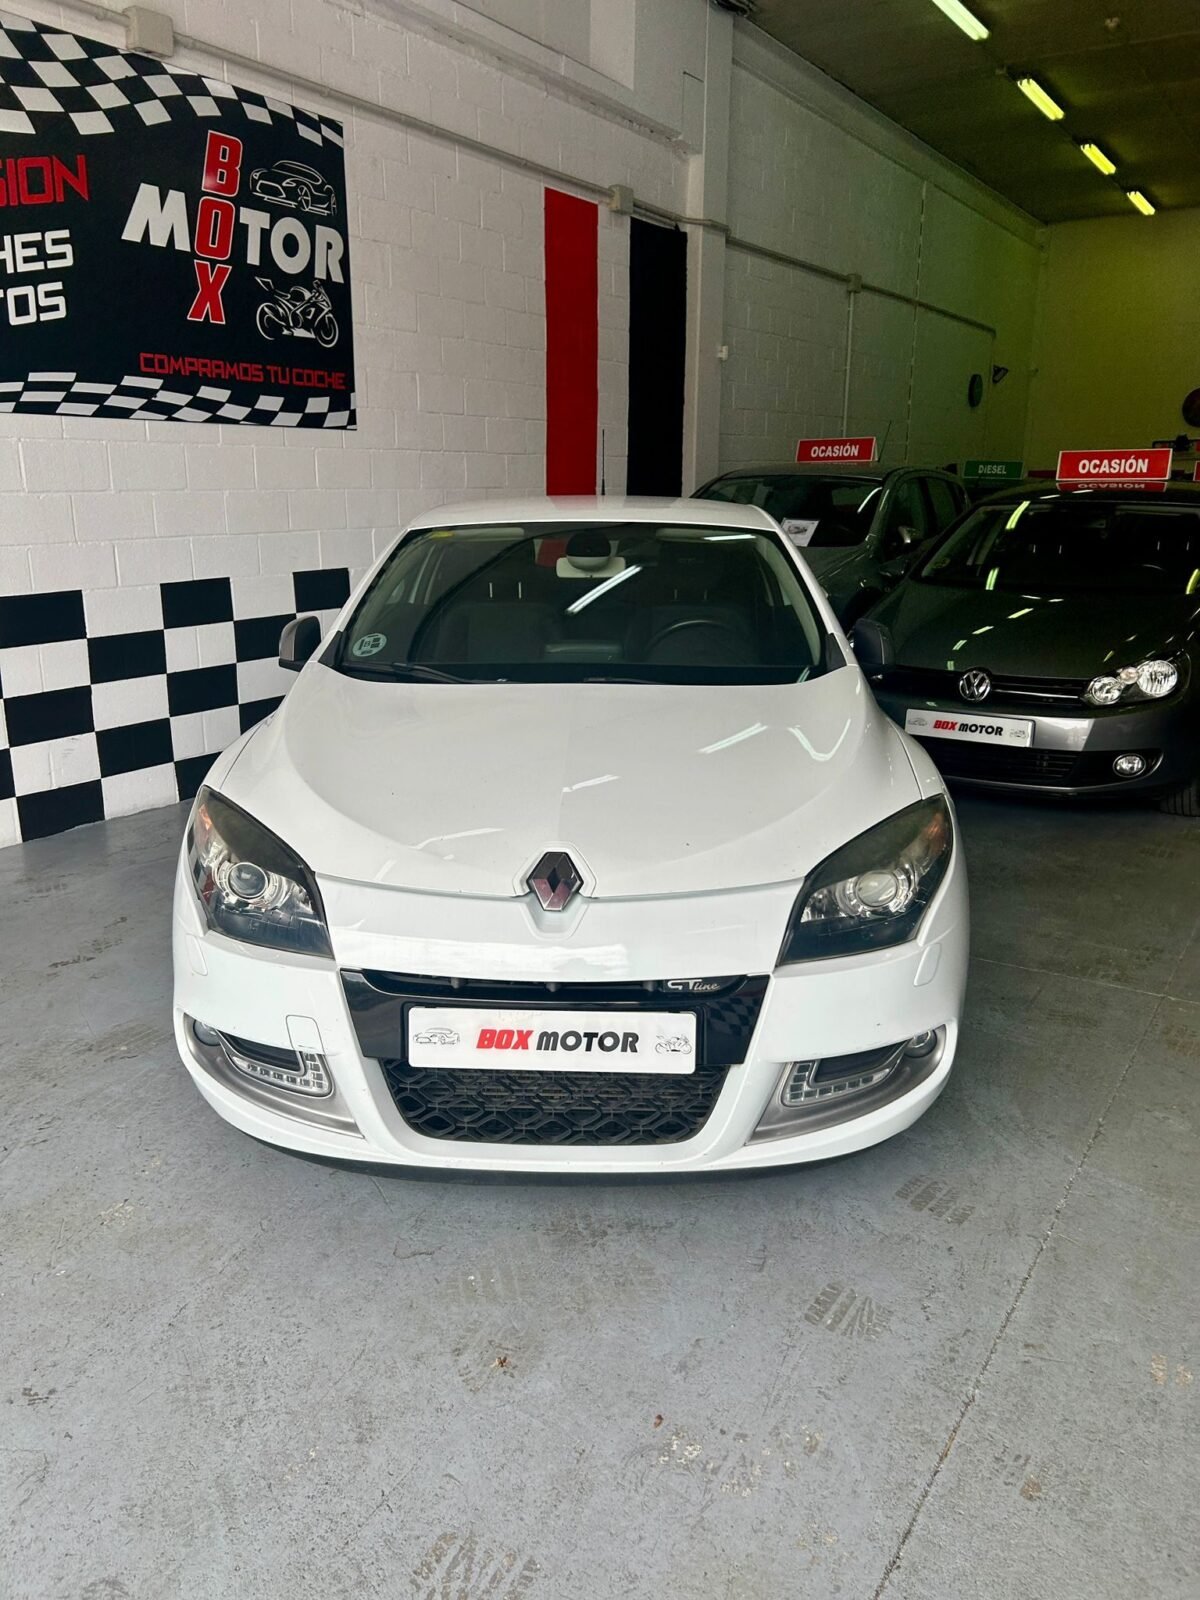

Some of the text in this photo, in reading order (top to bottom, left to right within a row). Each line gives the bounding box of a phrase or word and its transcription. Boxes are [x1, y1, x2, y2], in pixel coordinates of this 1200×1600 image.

[0, 154, 89, 207] ION
[121, 182, 345, 284] MOTOR
[187, 130, 243, 324] BOX
[0, 281, 67, 326] OS
[139, 352, 346, 390] COMPRAMOS TU COCHE
[810, 443, 860, 458] OCASIÓN
[1078, 456, 1149, 474] OCASIÓN
[933, 719, 1004, 737] BOX MOTOR
[476, 1028, 640, 1054] BOX MOTOR
